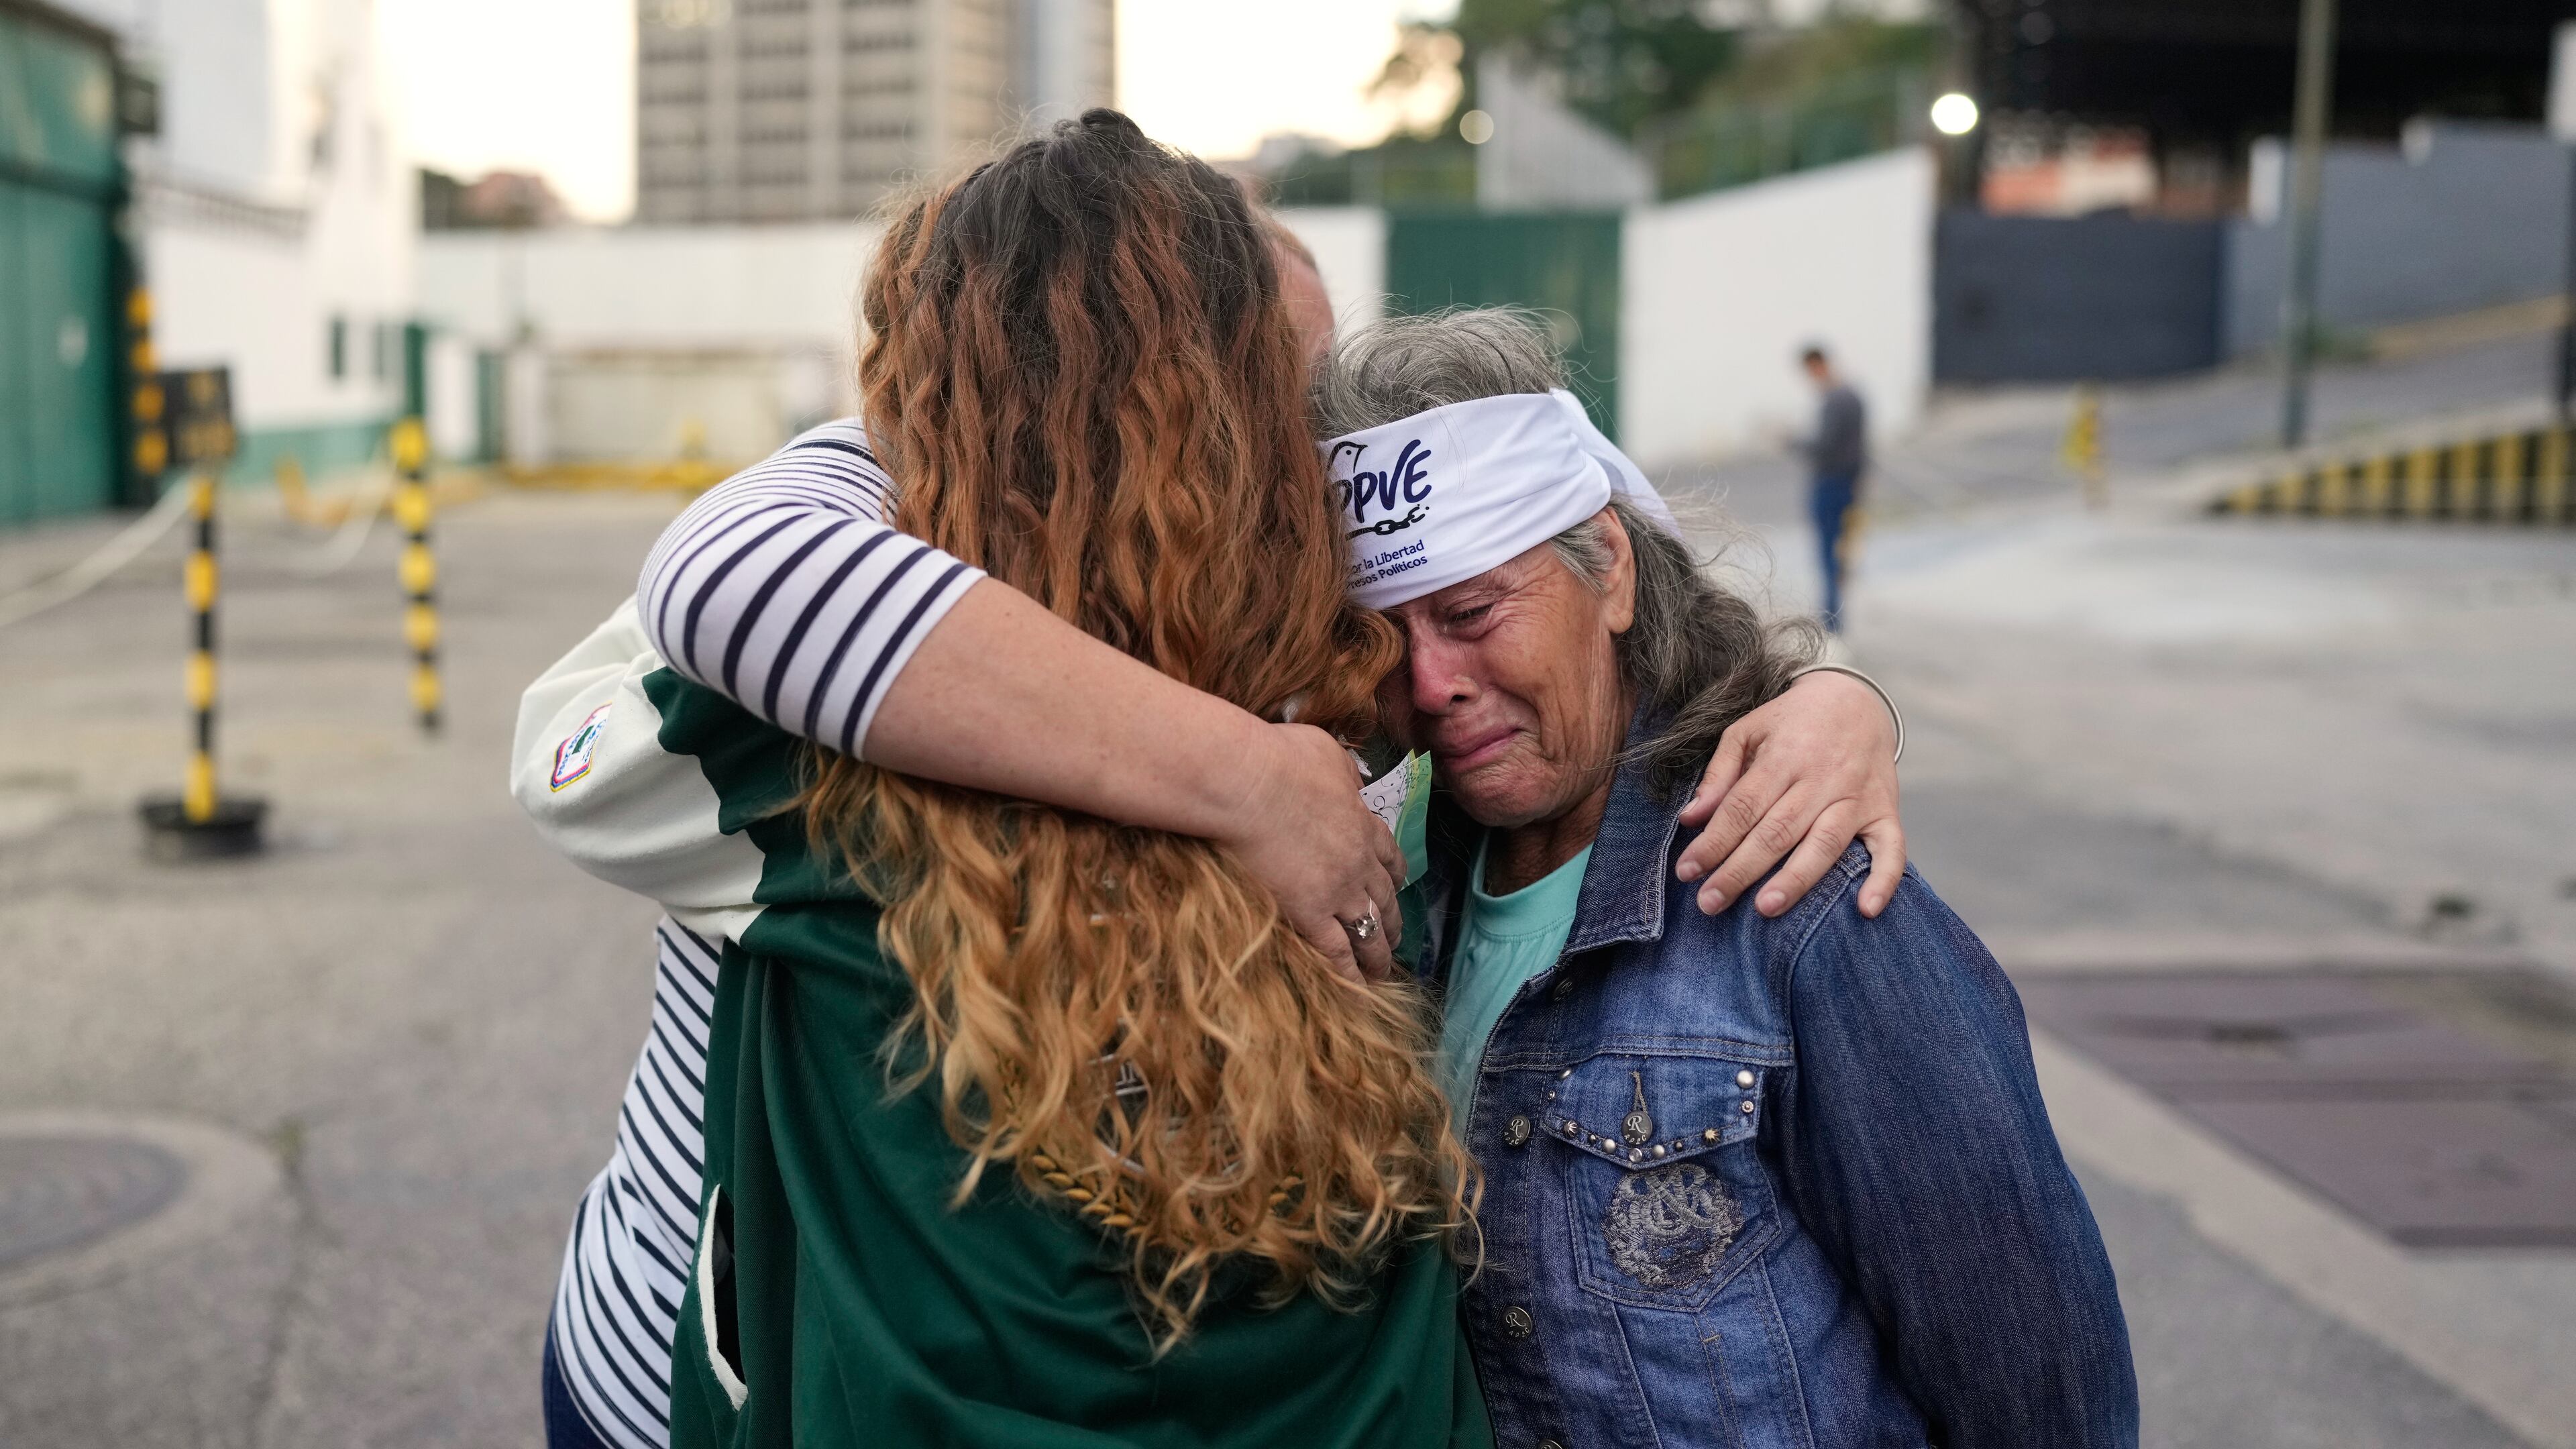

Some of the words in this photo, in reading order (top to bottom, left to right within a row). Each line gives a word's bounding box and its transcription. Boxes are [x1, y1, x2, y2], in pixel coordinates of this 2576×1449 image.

[1363, 558, 1374, 570] la
[1375, 539, 1425, 566] Libertad
[1377, 555, 1428, 579] Políticos
[1509, 1118, 1525, 1138] R
[1627, 1115, 1647, 1134] R
[1505, 1312, 1527, 1328] R
